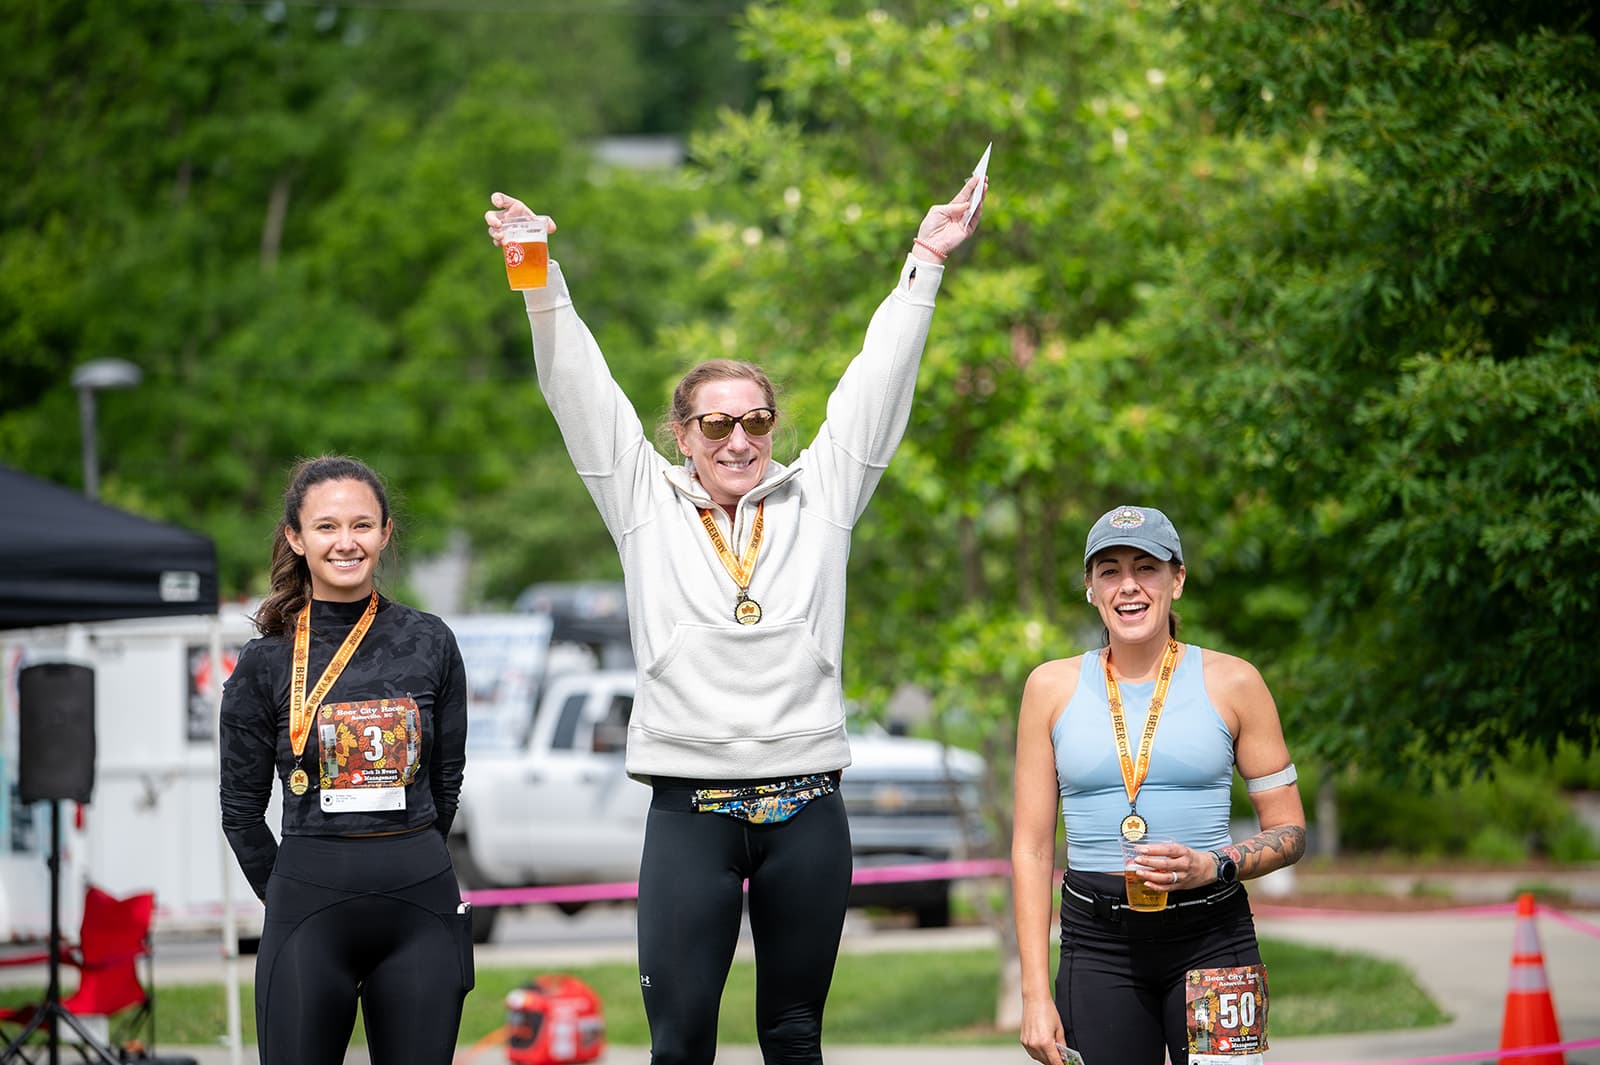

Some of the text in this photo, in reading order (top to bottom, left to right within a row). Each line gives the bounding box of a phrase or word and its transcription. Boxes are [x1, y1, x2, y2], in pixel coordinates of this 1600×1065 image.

[702, 516, 727, 553] BEER CITY
[294, 666, 304, 712] BEER CITY
[360, 707, 377, 715] City
[363, 725, 384, 762] 3
[1113, 715, 1130, 759] BEER CITY
[1140, 714, 1158, 759] BEER CITY
[1219, 991, 1256, 1029] 50
